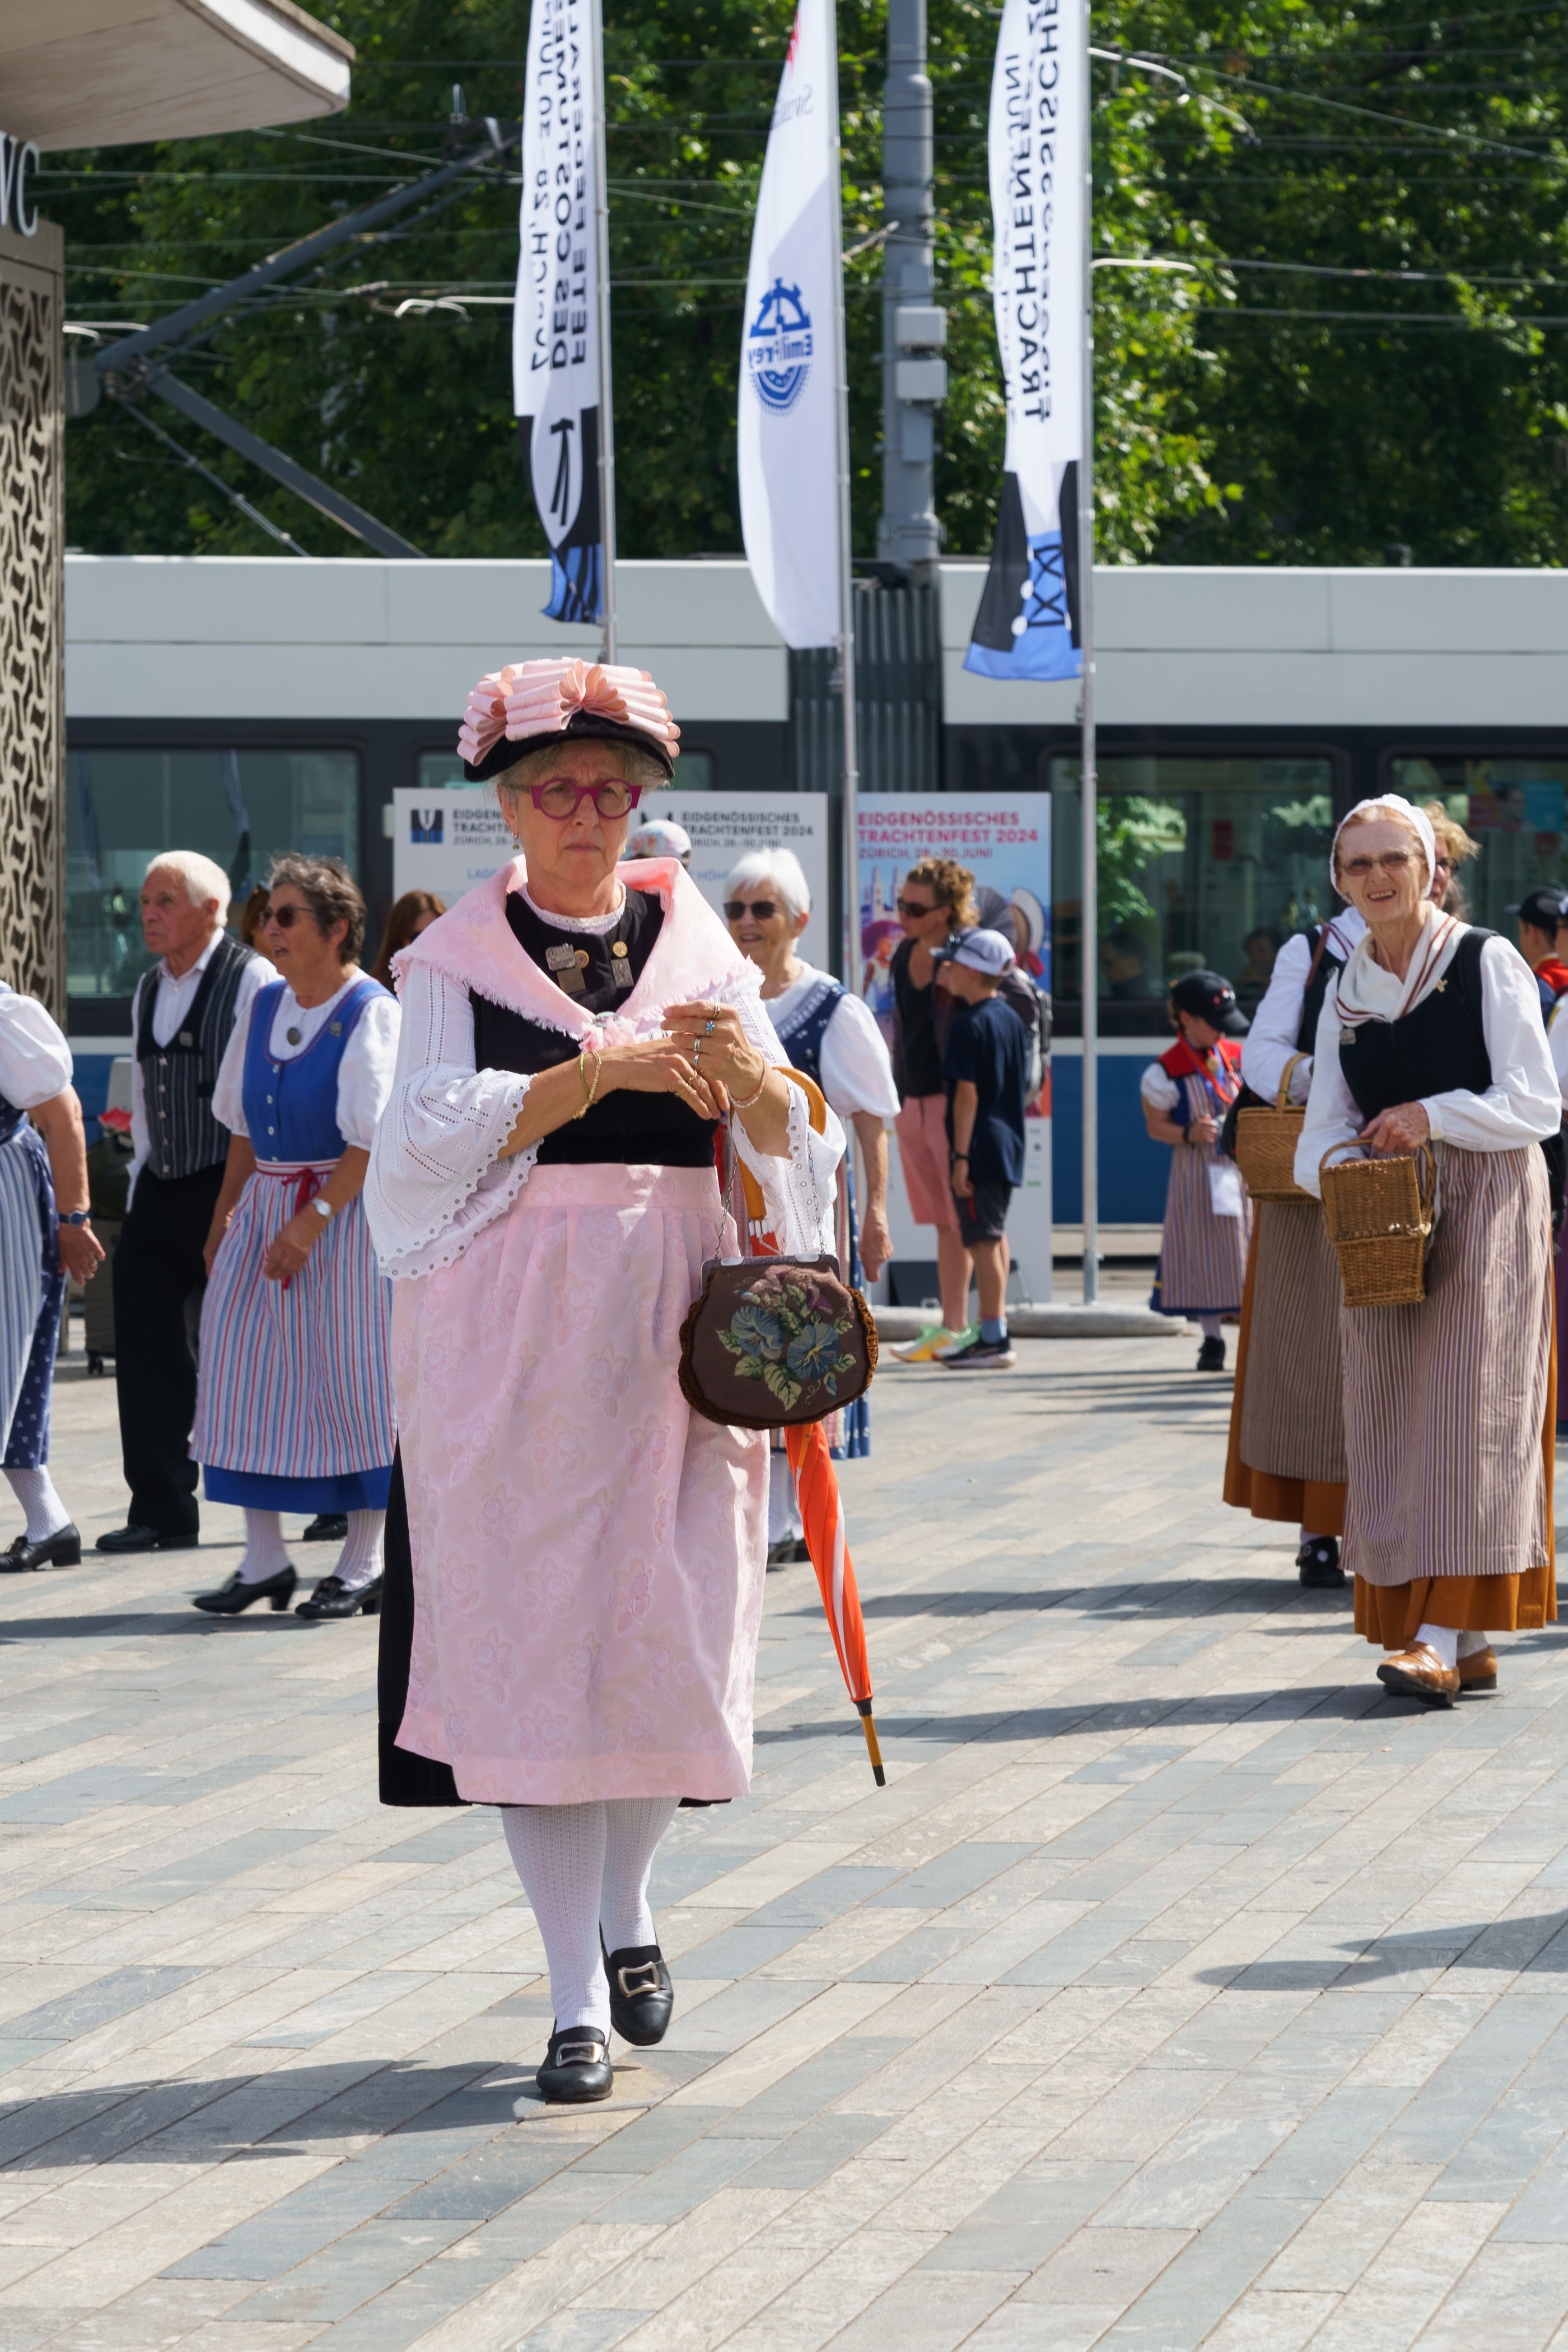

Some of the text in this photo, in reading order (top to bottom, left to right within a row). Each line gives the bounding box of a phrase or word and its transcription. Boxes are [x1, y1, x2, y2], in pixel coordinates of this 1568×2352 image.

[682, 810, 800, 823] EIDGENÖSSISCHES
[858, 810, 1019, 826] EIDGENÖSSISCHES
[683, 824, 814, 836] TRACHTENFEST 2024
[858, 828, 1038, 843] TRACHTENFEST 2024
[963, 847, 993, 859] JUNI
